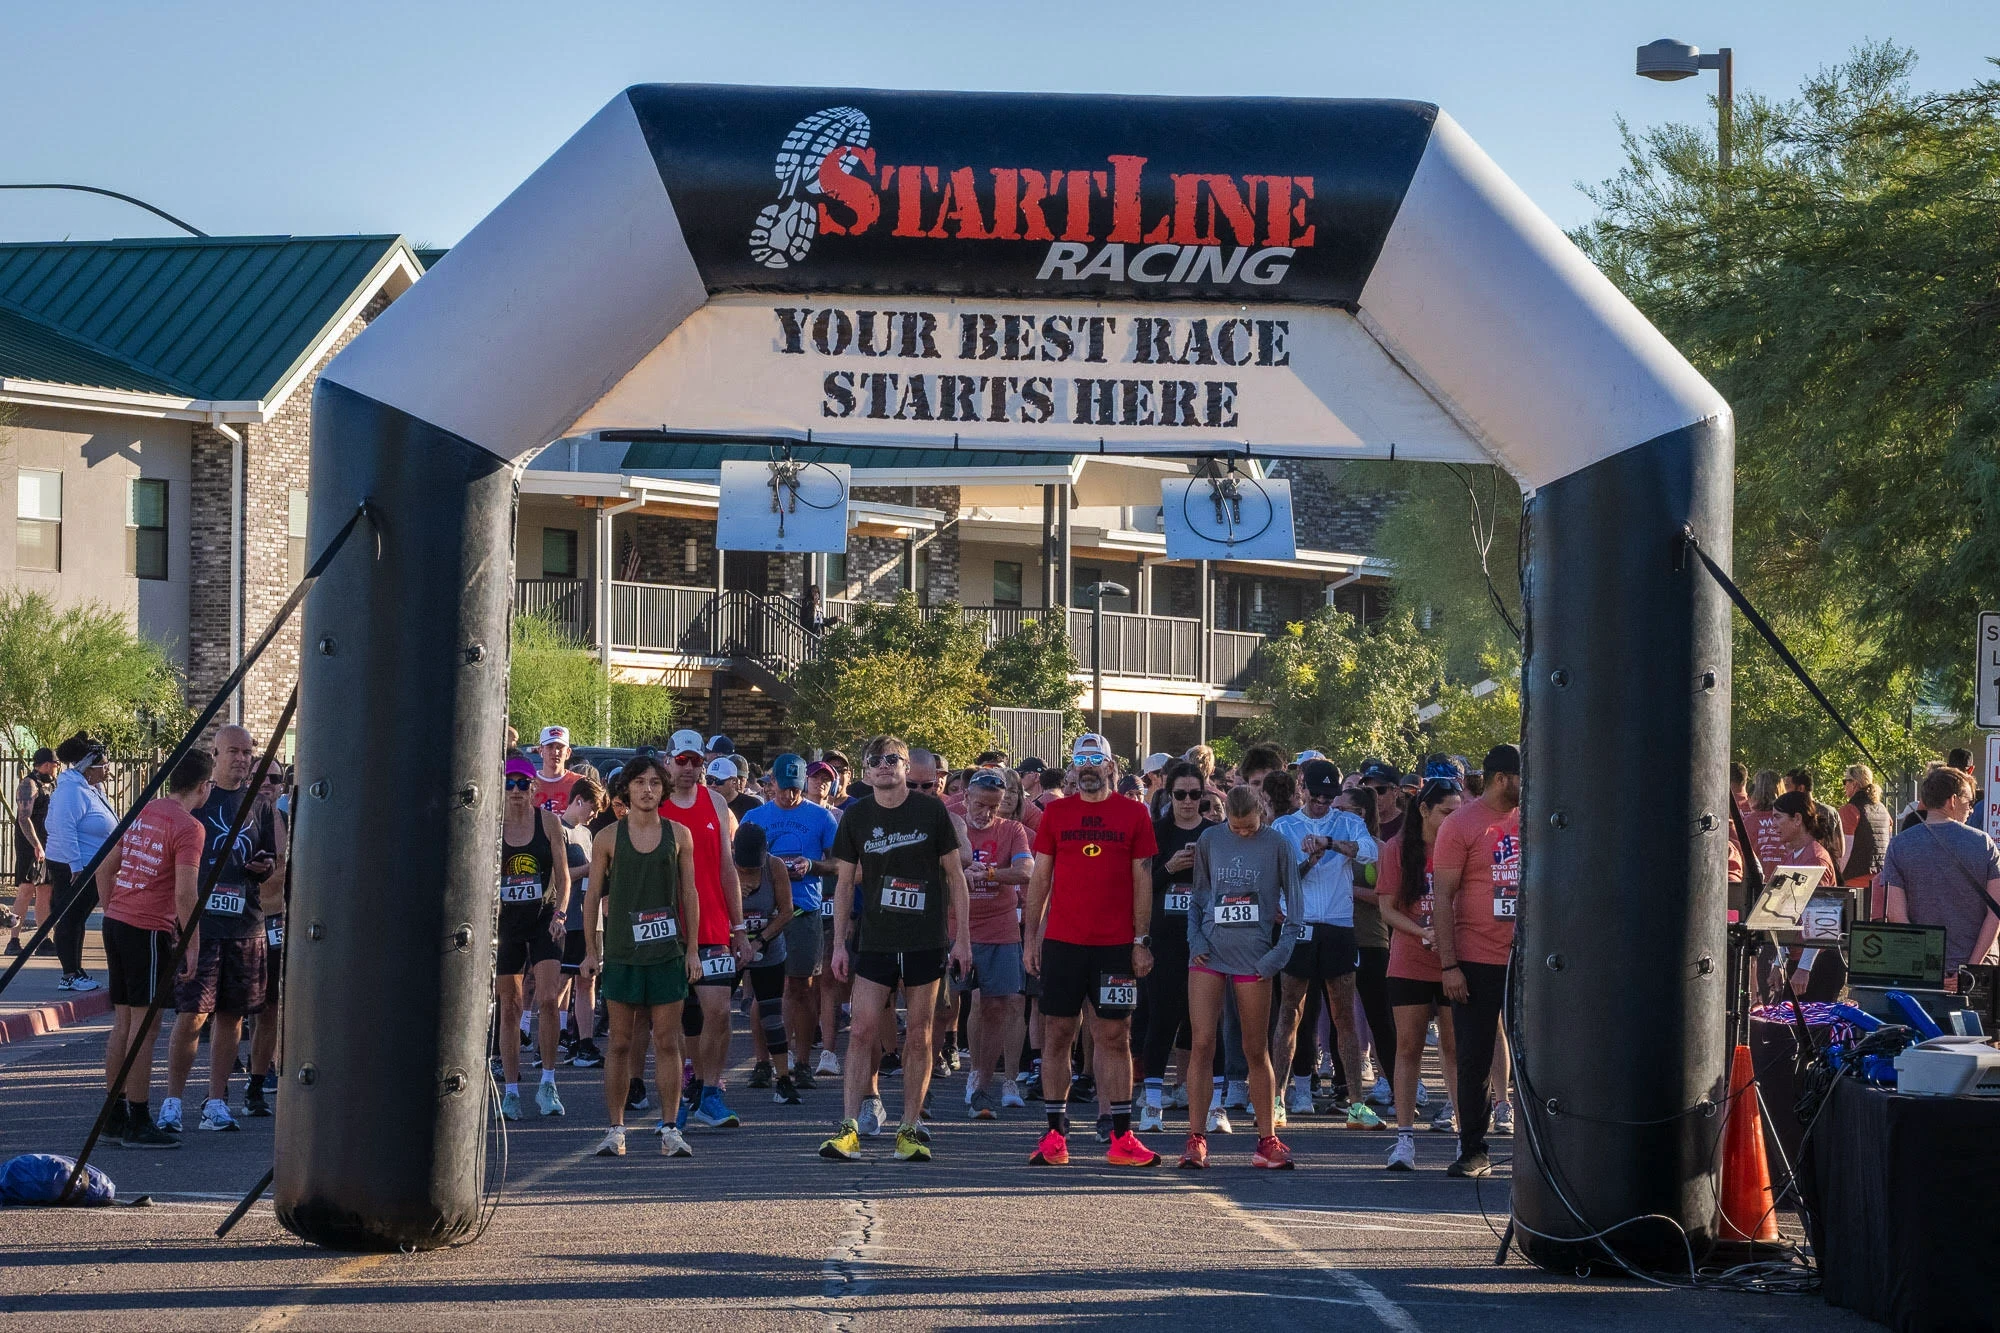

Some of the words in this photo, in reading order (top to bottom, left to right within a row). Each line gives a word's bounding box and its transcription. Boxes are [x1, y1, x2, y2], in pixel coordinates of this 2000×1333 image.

[1035, 241, 1296, 285] RACING
[774, 308, 942, 358] YOUR
[958, 313, 1116, 364] BEST
[1134, 317, 1290, 367] RACE
[823, 371, 1055, 425] STARTS
[1072, 377, 1239, 428] HERE
[1082, 816, 1105, 827] MR.
[1061, 830, 1125, 842] INCREDIBLE
[1217, 867, 1261, 883] HIGLEY
[508, 886, 535, 900] 479
[889, 890, 918, 908] 110
[211, 895, 239, 912] 590
[1221, 906, 1251, 921] 438
[640, 921, 669, 940] 209
[709, 958, 733, 973] 172
[1107, 988, 1133, 1003] 439
